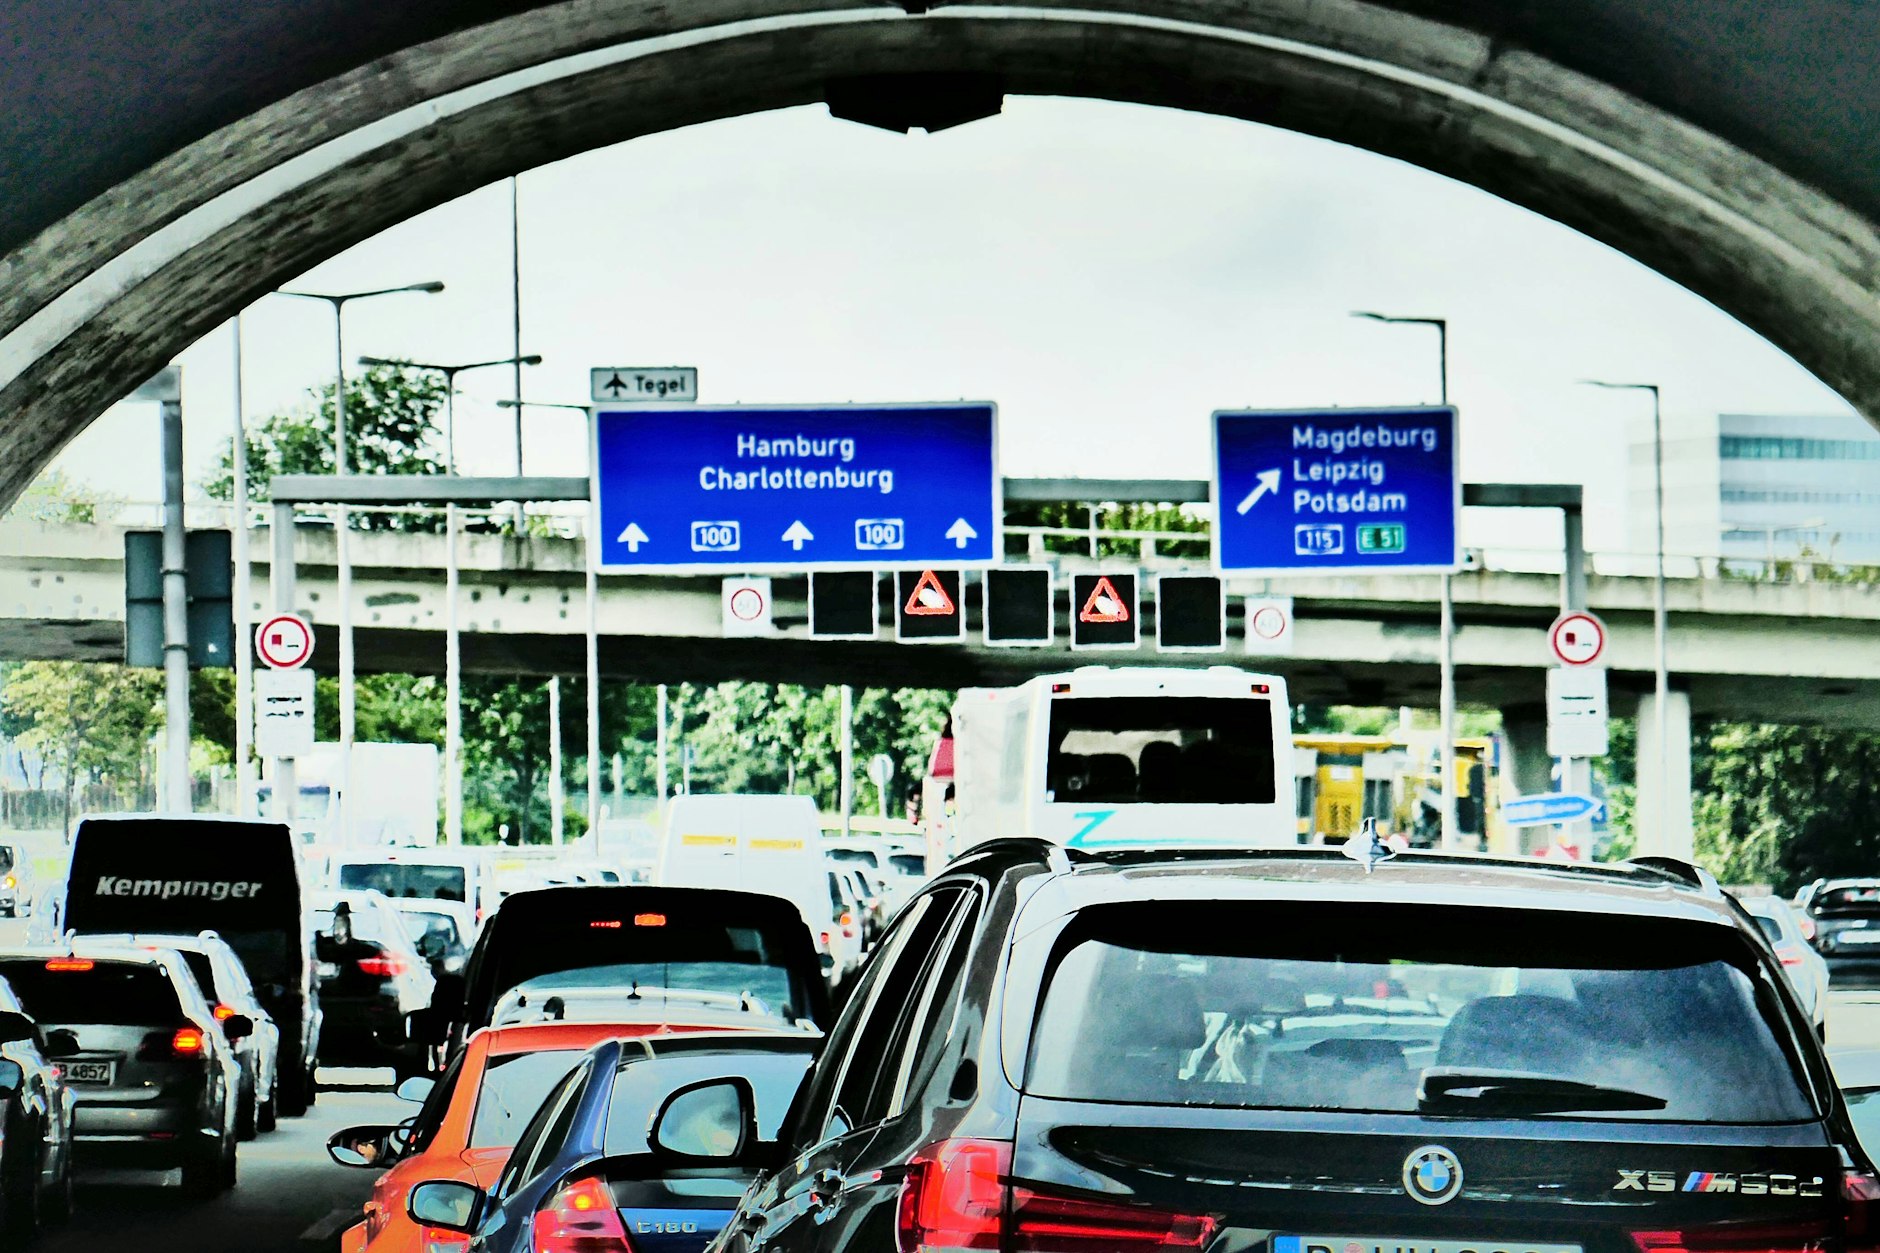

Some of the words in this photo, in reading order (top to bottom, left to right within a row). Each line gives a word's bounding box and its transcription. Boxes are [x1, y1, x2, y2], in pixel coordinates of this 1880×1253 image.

[634, 375, 686, 398] Tegel
[737, 433, 855, 462] Hamburg
[1292, 425, 1437, 452] Magdeburg
[699, 466, 894, 494] Charlottenburg
[1293, 457, 1385, 485] Leipzig
[1293, 489, 1407, 514] Potsdam
[700, 526, 733, 546] 100
[864, 524, 896, 545] 100
[1305, 530, 1334, 549] 115
[1361, 530, 1375, 549] E
[1380, 529, 1401, 548] 51
[95, 875, 264, 901] Kempinger
[70, 1064, 107, 1080] 4857
[1612, 1169, 1677, 1192] X5
[636, 1221, 652, 1234] C
[654, 1221, 699, 1234] 180
